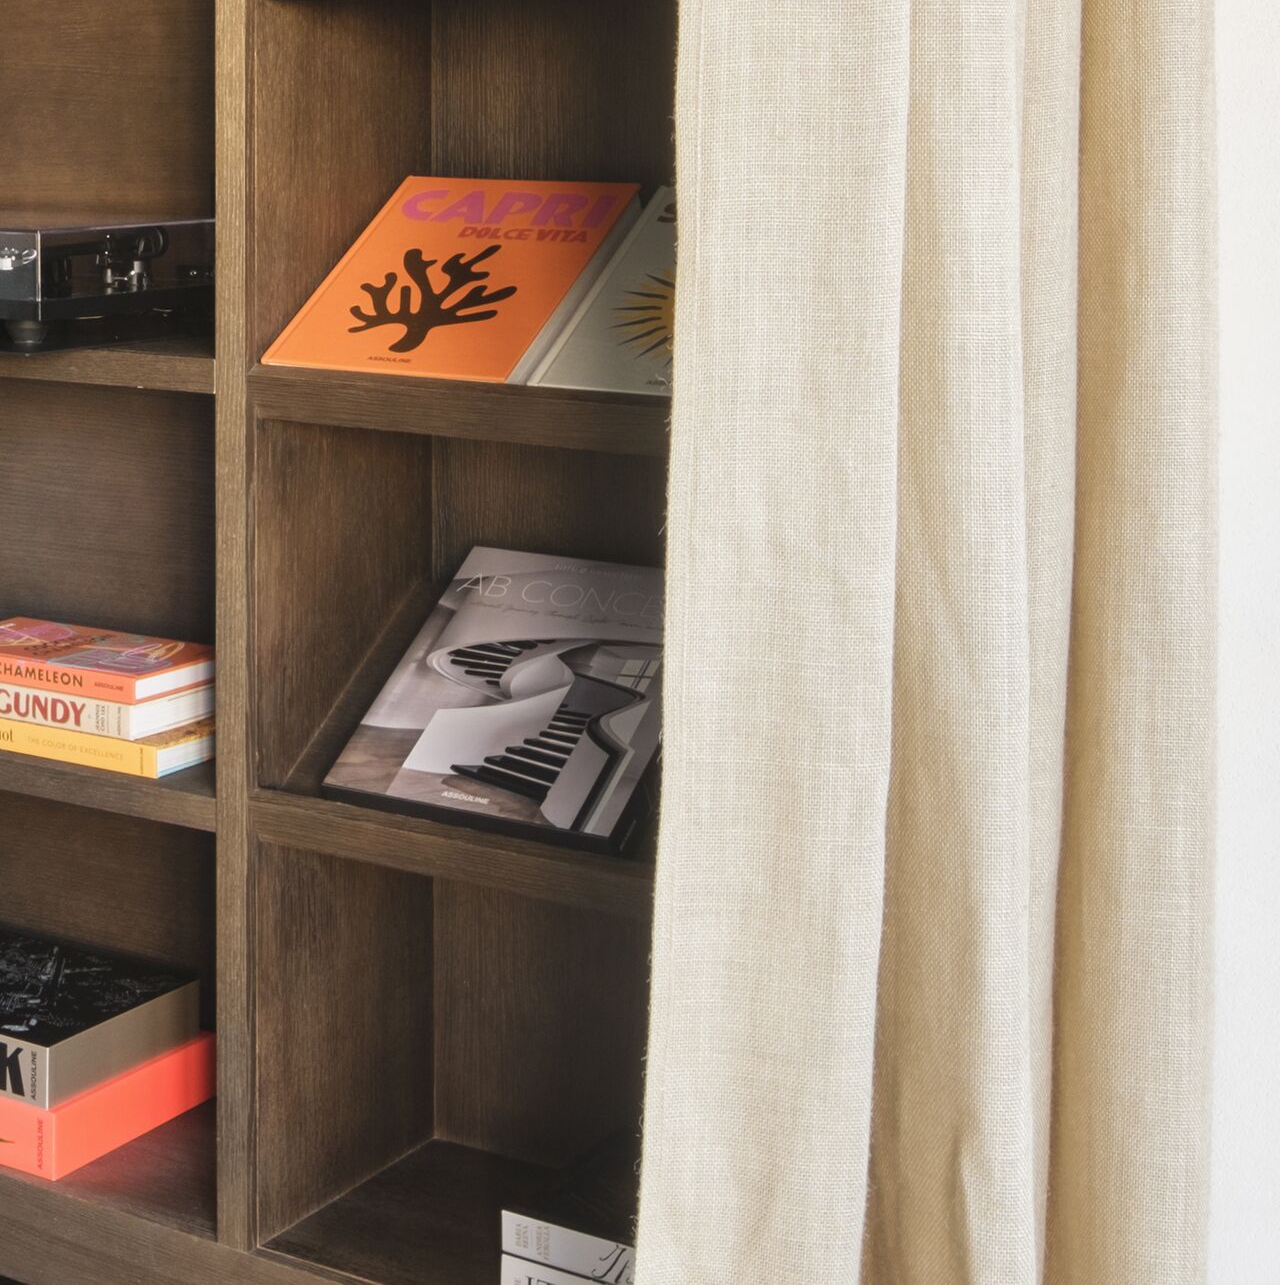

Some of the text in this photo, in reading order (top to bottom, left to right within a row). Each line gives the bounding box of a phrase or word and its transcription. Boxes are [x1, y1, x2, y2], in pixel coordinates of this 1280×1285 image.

[401, 188, 617, 229] CAPRI
[458, 226, 589, 244] DOLCE VITA
[367, 355, 412, 364] ASSOULINE
[456, 572, 512, 597] AB
[441, 790, 490, 806] ASSOULINE
